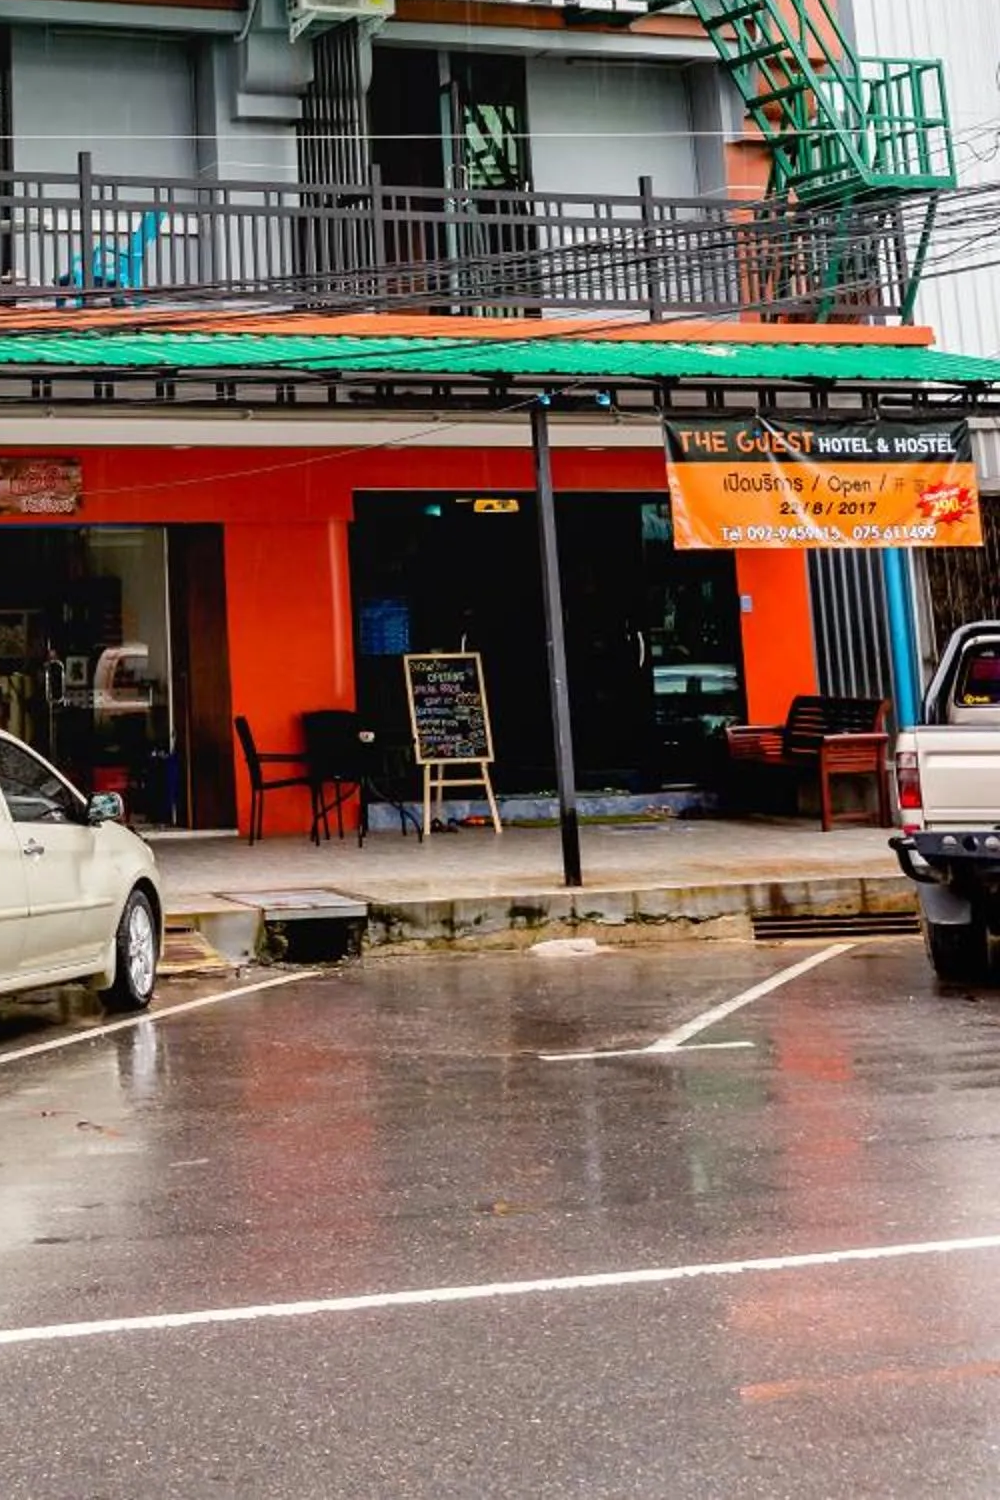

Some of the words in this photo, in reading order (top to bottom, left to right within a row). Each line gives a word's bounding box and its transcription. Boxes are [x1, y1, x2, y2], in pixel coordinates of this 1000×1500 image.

[679, 430, 729, 453] THE
[735, 428, 814, 454] GUEST
[818, 437, 873, 453] HOTEL
[877, 437, 890, 453] &
[894, 437, 957, 453] HOSTEL
[723, 471, 804, 493] เปิดบริการ
[827, 475, 871, 498] Open
[838, 501, 877, 515] 2017
